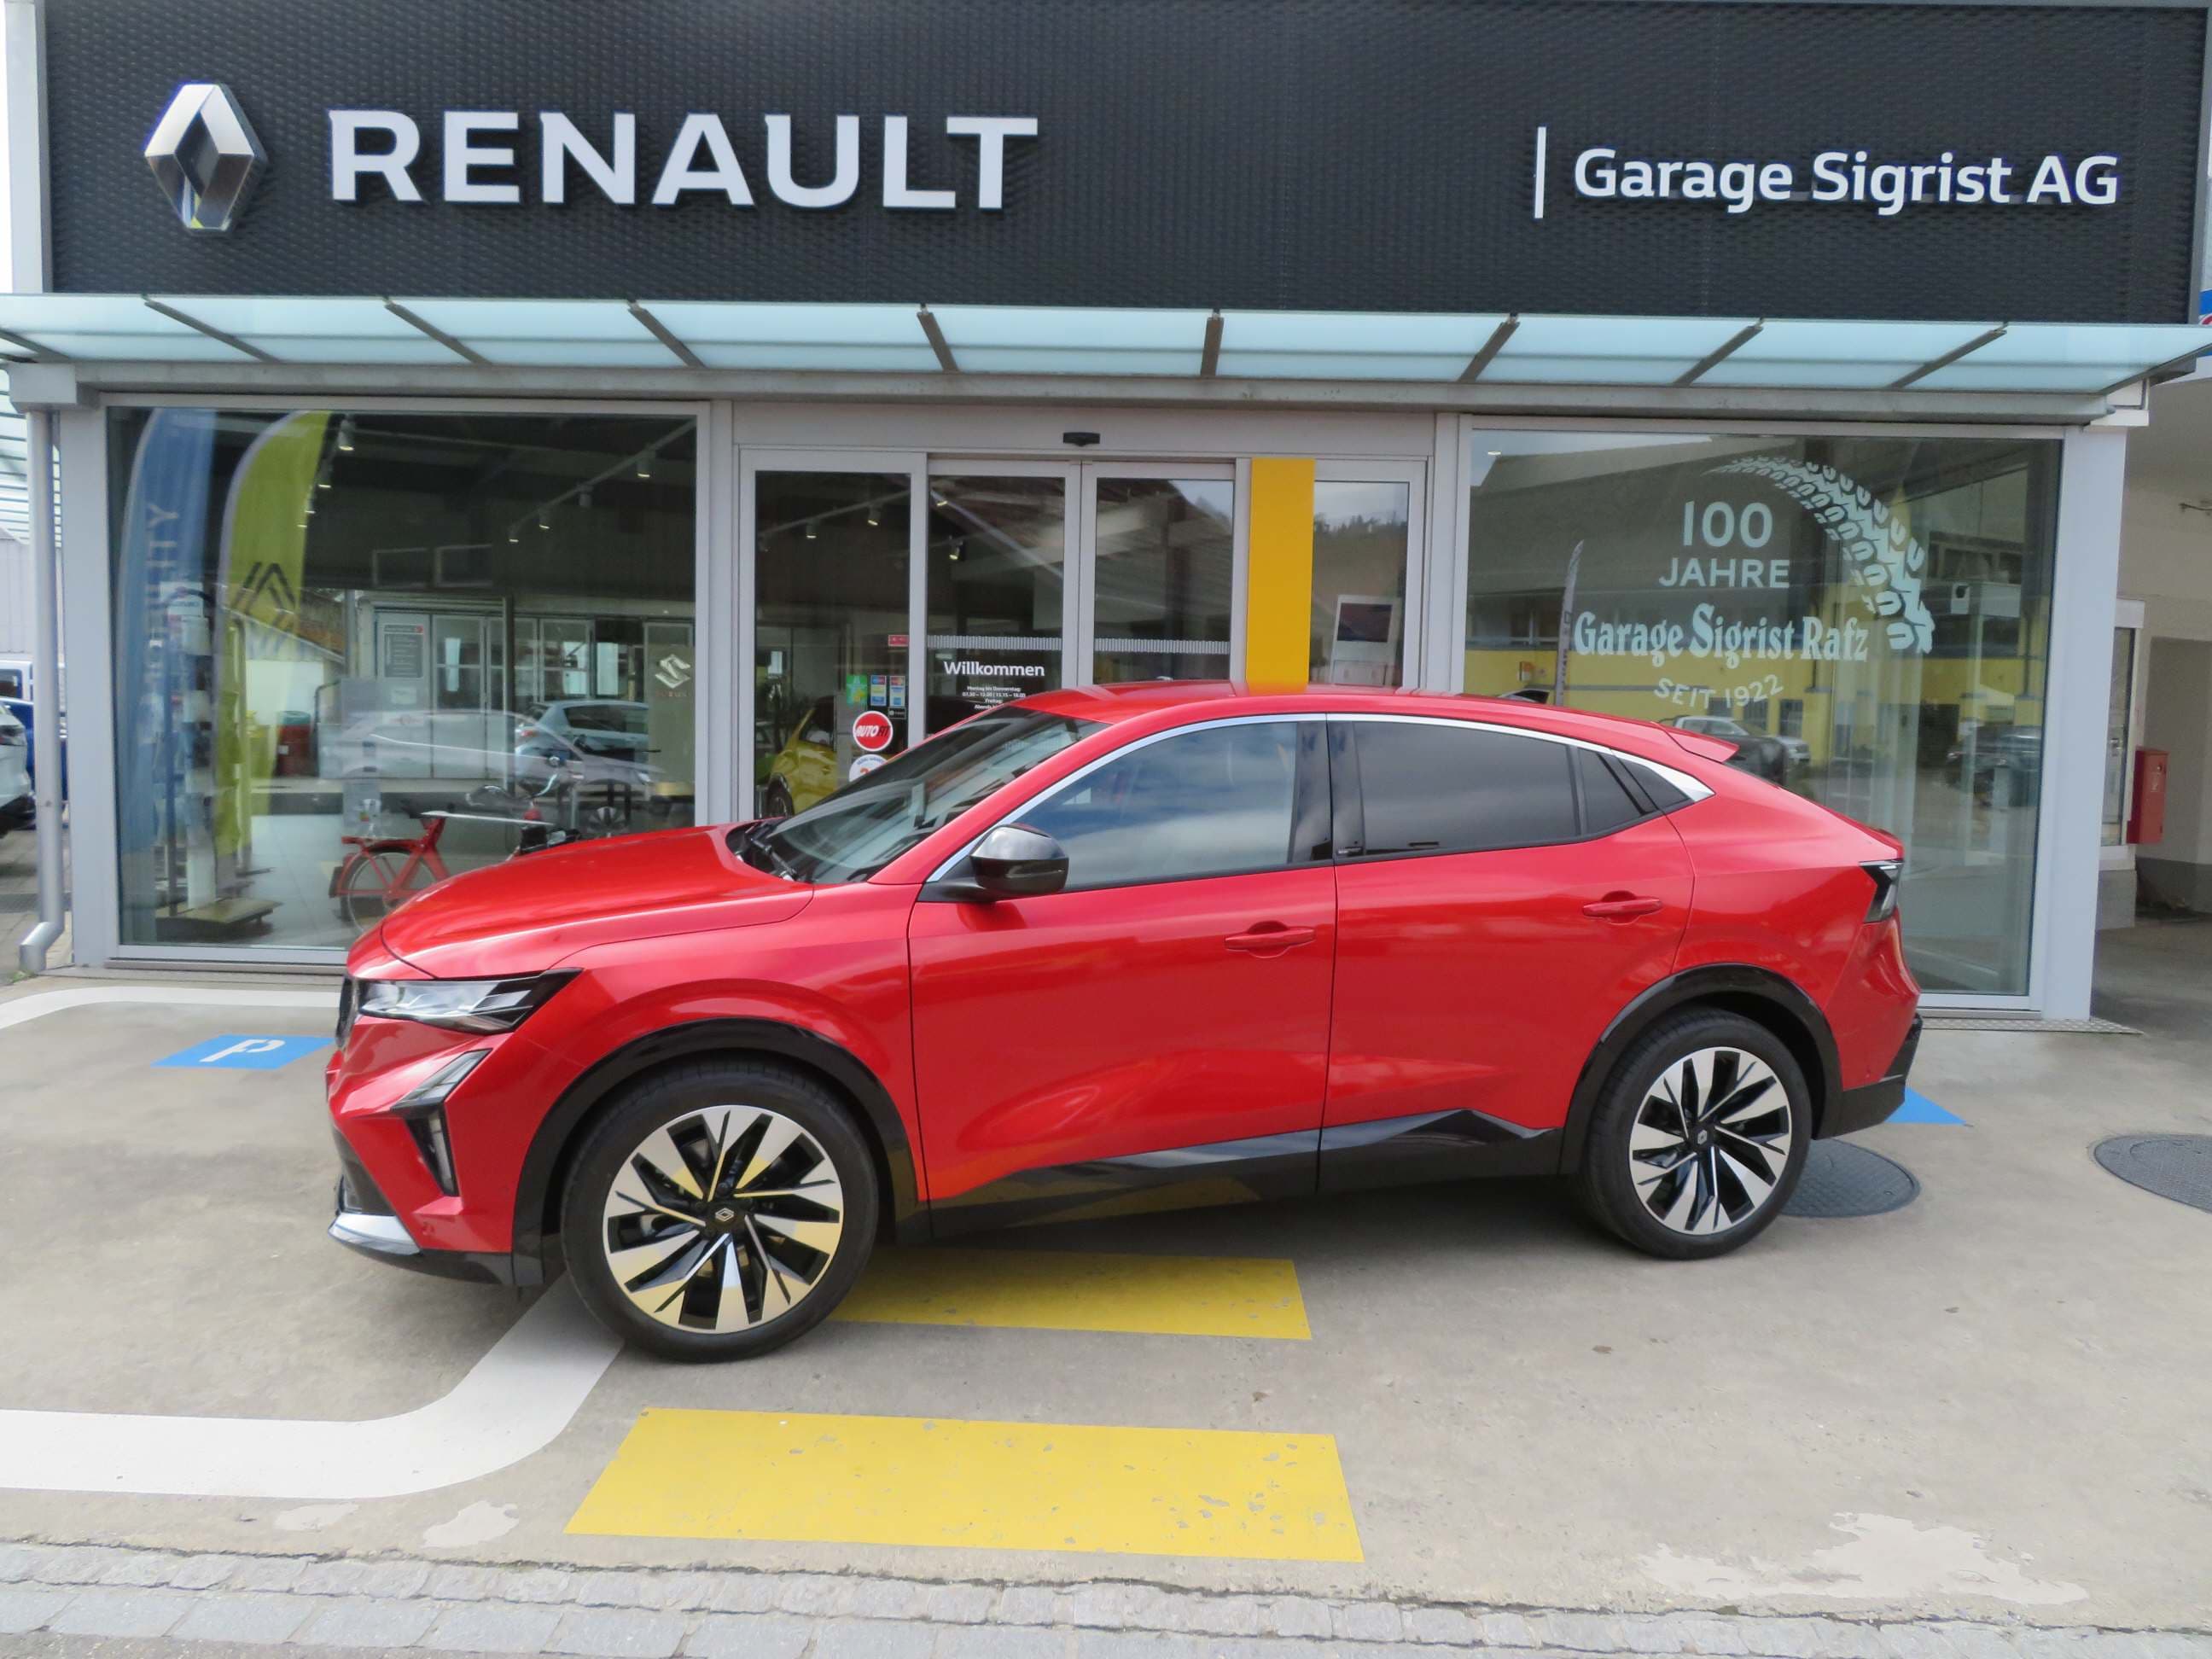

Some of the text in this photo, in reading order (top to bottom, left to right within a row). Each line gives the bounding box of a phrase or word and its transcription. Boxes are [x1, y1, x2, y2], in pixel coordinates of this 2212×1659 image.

[329, 109, 1039, 210] RENAULT
[1574, 147, 2119, 216] Garage Sigrist AG
[1683, 500, 1773, 548] 100
[1658, 557, 1790, 589] JAHRE
[1574, 611, 1684, 668] Garage
[1689, 602, 1795, 669] Sigrist
[1800, 616, 1869, 663] Rafz
[944, 661, 1045, 677] Willkommen
[1654, 674, 1784, 709] SEIT 1922
[199, 1039, 286, 1062] P
